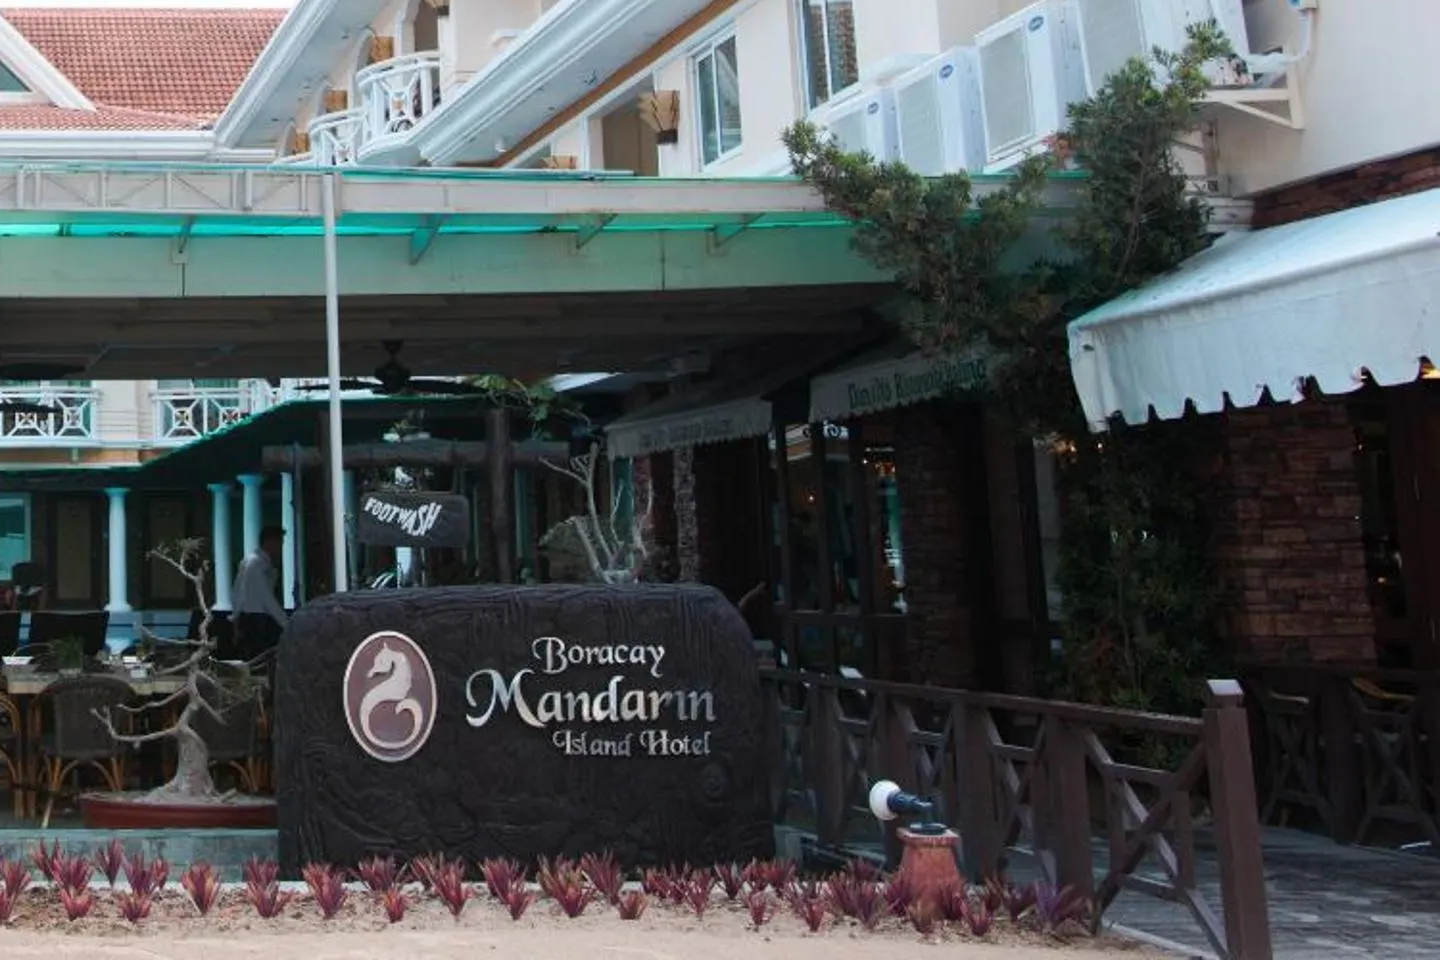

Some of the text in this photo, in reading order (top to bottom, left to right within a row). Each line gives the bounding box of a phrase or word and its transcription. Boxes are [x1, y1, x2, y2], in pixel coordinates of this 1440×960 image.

[364, 496, 442, 537] FOOTWASH
[531, 637, 665, 678] Boracay
[465, 669, 717, 728] Mandarin
[552, 729, 711, 757] Island Hotel
